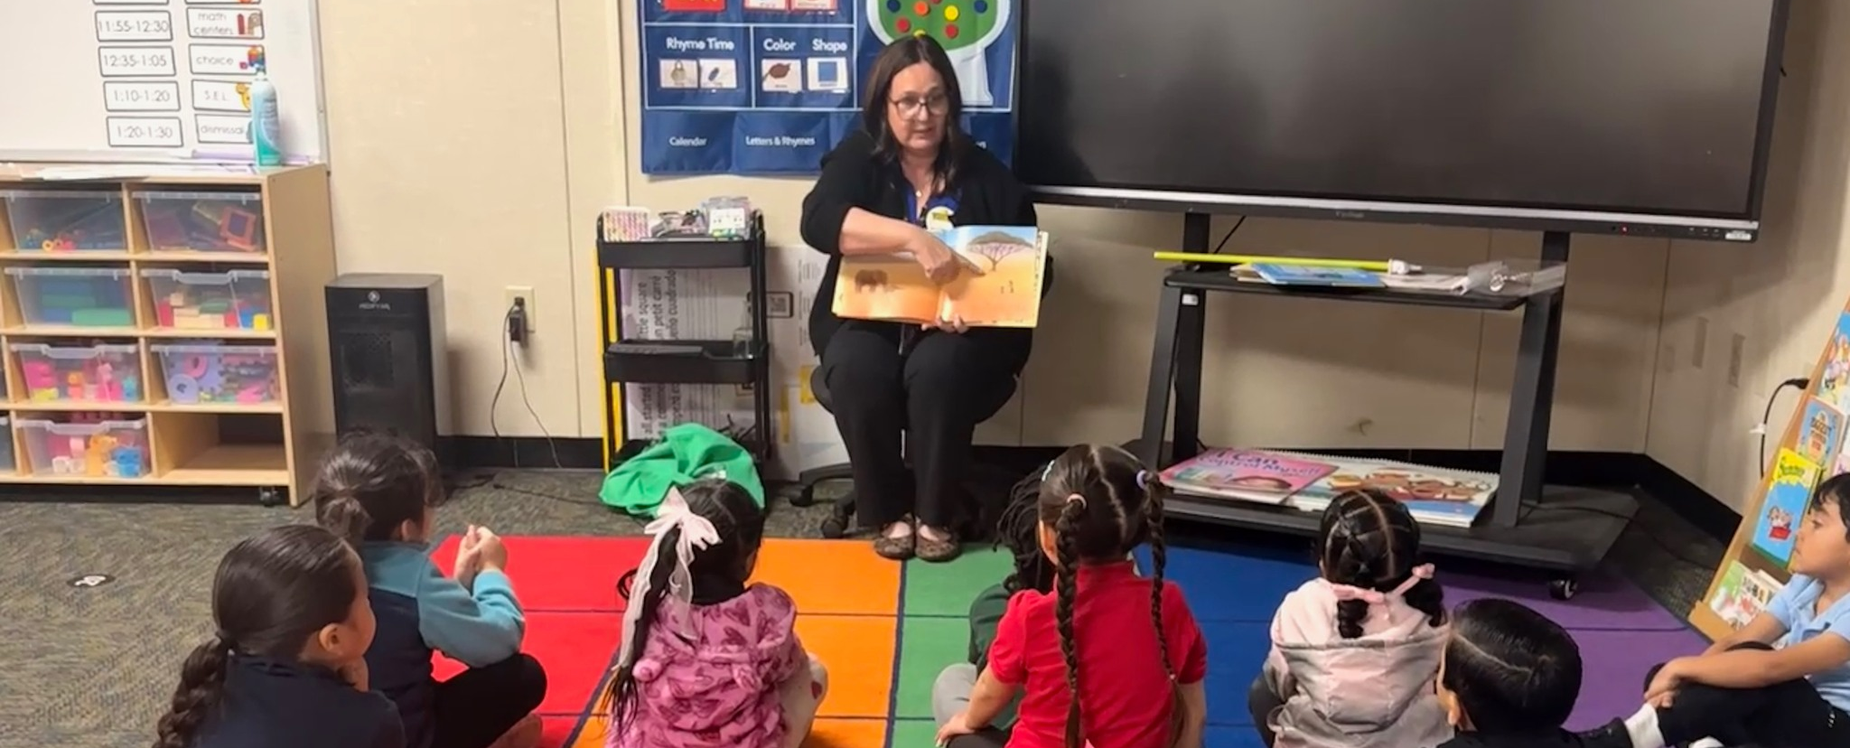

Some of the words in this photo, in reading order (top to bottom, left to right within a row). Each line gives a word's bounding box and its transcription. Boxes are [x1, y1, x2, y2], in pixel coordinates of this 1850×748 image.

[99, 20, 169, 32] 11:55-12:30
[666, 37, 705, 52] Rhyme
[706, 37, 734, 50] Time
[763, 37, 796, 50] Color
[812, 38, 848, 53] Shape
[104, 55, 167, 67] 12:35-1:05
[196, 56, 234, 65] choice
[114, 89, 171, 102] 1:10-1:20
[117, 125, 173, 138] 1:20-1:30
[669, 136, 707, 147] Calendar
[746, 135, 772, 146] Letters
[774, 136, 781, 146] &
[782, 136, 815, 148] Rhymes
[1233, 453, 1279, 465] Can
